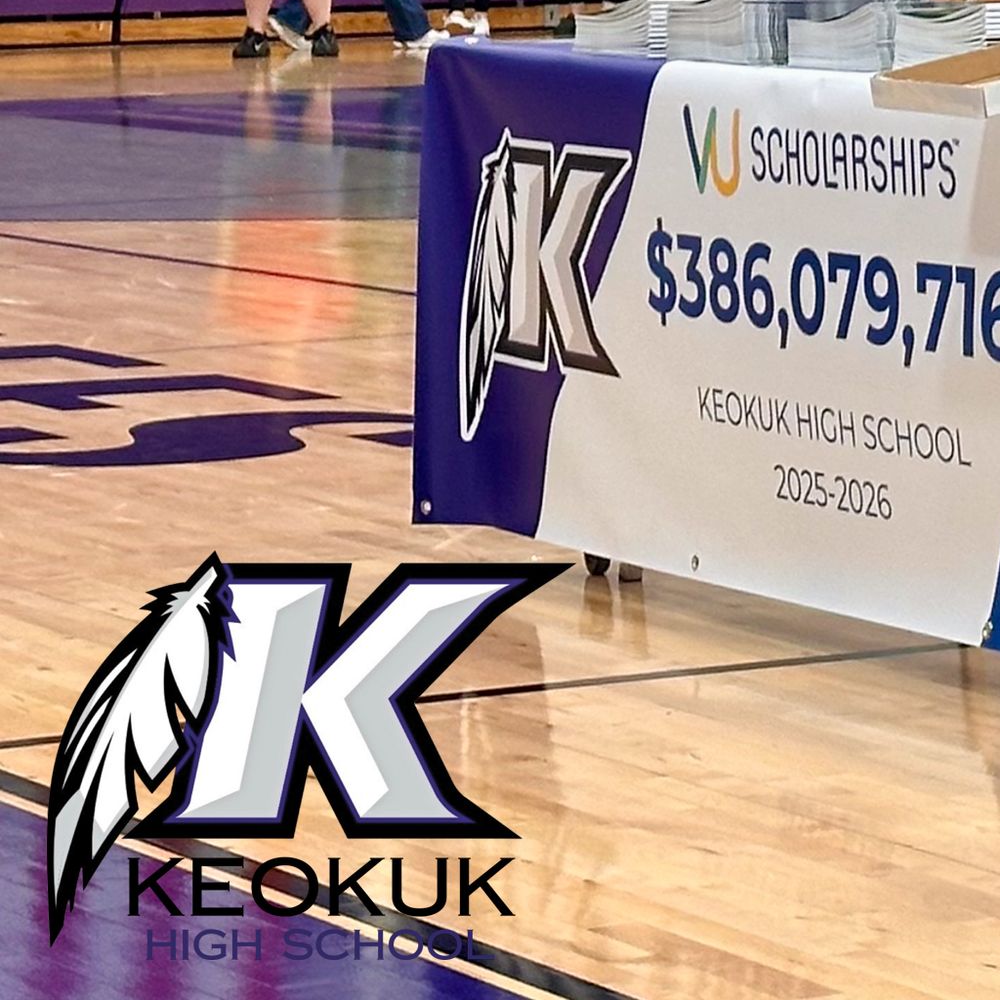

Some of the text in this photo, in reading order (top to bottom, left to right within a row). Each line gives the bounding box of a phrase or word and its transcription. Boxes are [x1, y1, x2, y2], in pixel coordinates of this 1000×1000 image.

[698, 386, 972, 467] KEOKUK HIGH SCHOOL
[774, 464, 892, 520] 2025-2026
